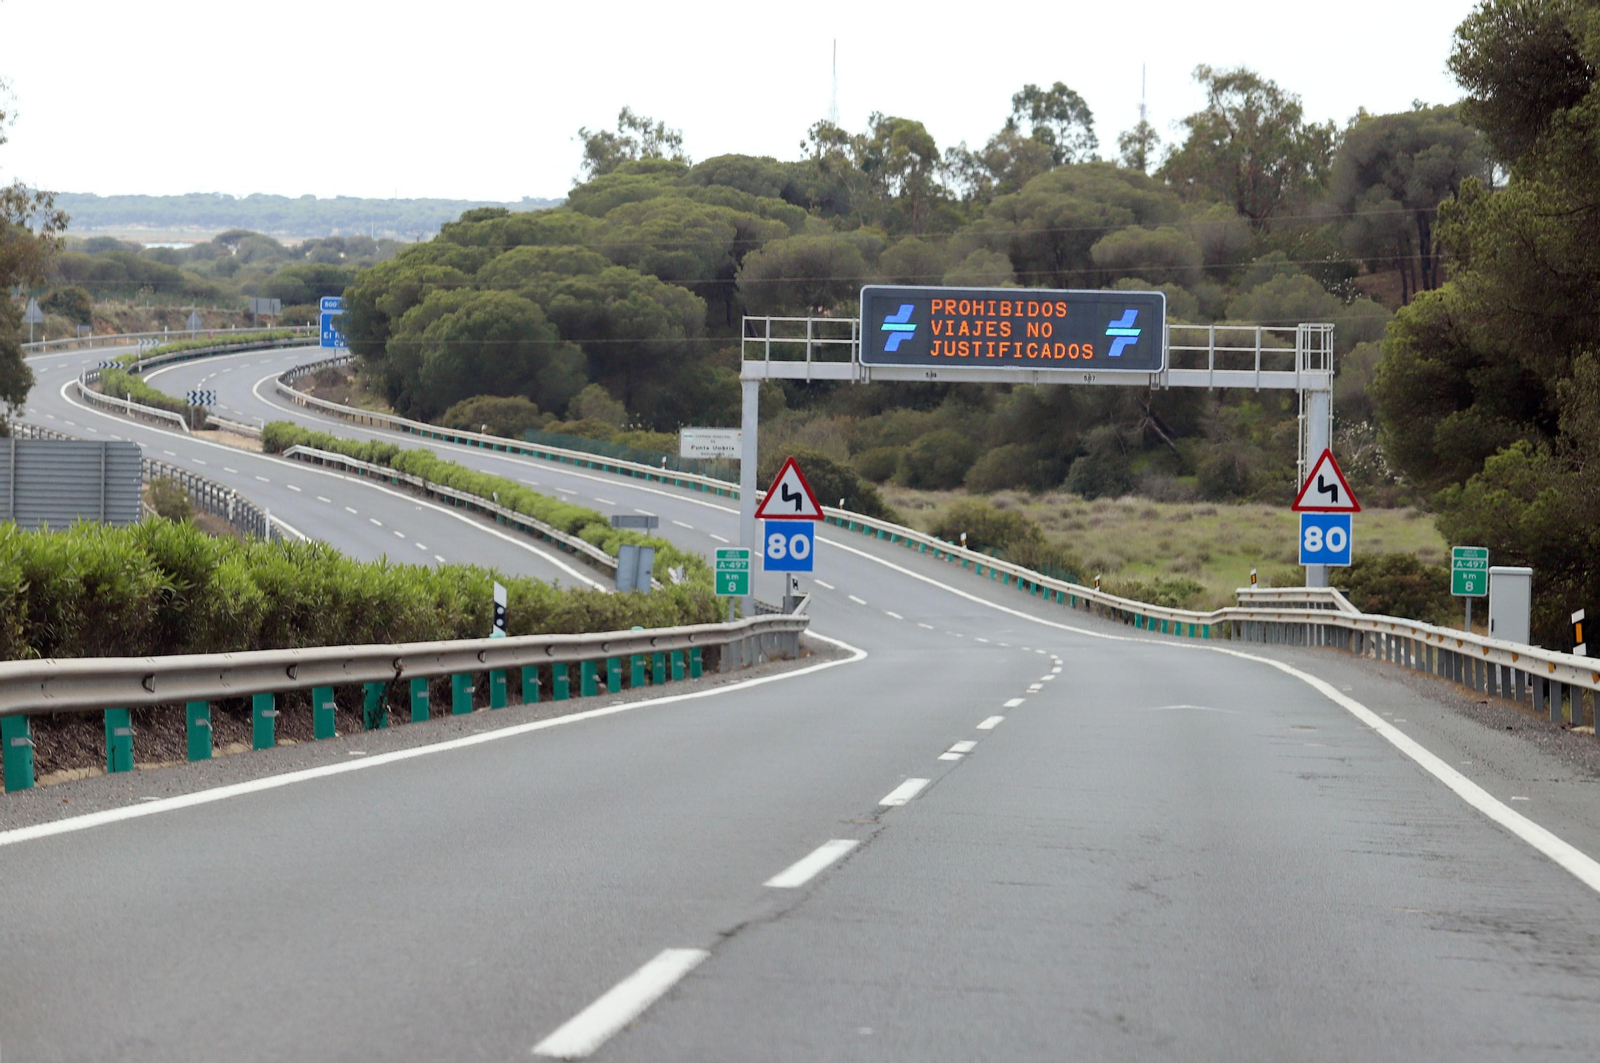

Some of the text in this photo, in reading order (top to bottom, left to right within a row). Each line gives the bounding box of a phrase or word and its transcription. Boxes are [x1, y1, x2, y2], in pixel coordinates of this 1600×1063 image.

[930, 299, 1067, 318] PROHIBIDOS
[930, 320, 1053, 338] VIAJES NO
[930, 340, 1094, 359] JUSTIFICADOS
[1304, 525, 1347, 553] 80
[767, 533, 811, 560] 80
[719, 561, 747, 569] A-497
[1456, 560, 1485, 568] A-497
[1462, 572, 1477, 580] km
[728, 581, 736, 592] 8
[1465, 581, 1474, 592] 8
